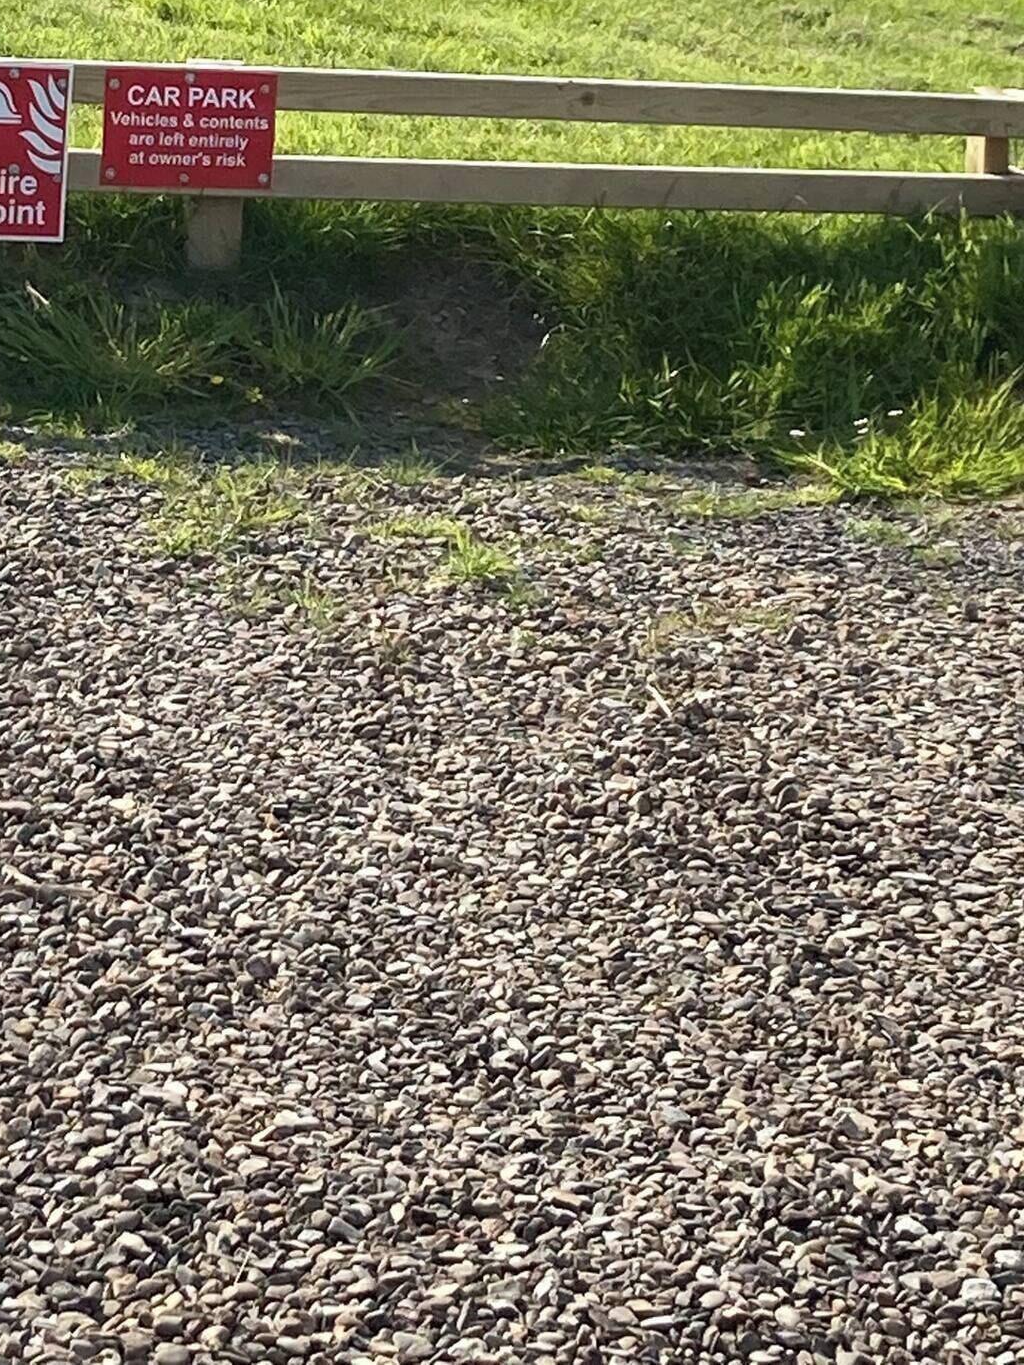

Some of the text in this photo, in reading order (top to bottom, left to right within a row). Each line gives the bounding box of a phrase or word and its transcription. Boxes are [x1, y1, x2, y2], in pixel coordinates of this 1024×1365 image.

[127, 85, 256, 109] CAR PARK
[110, 111, 269, 131] Vehicles & contents
[128, 131, 248, 151] are left entirely
[129, 151, 247, 167] at owner's risk
